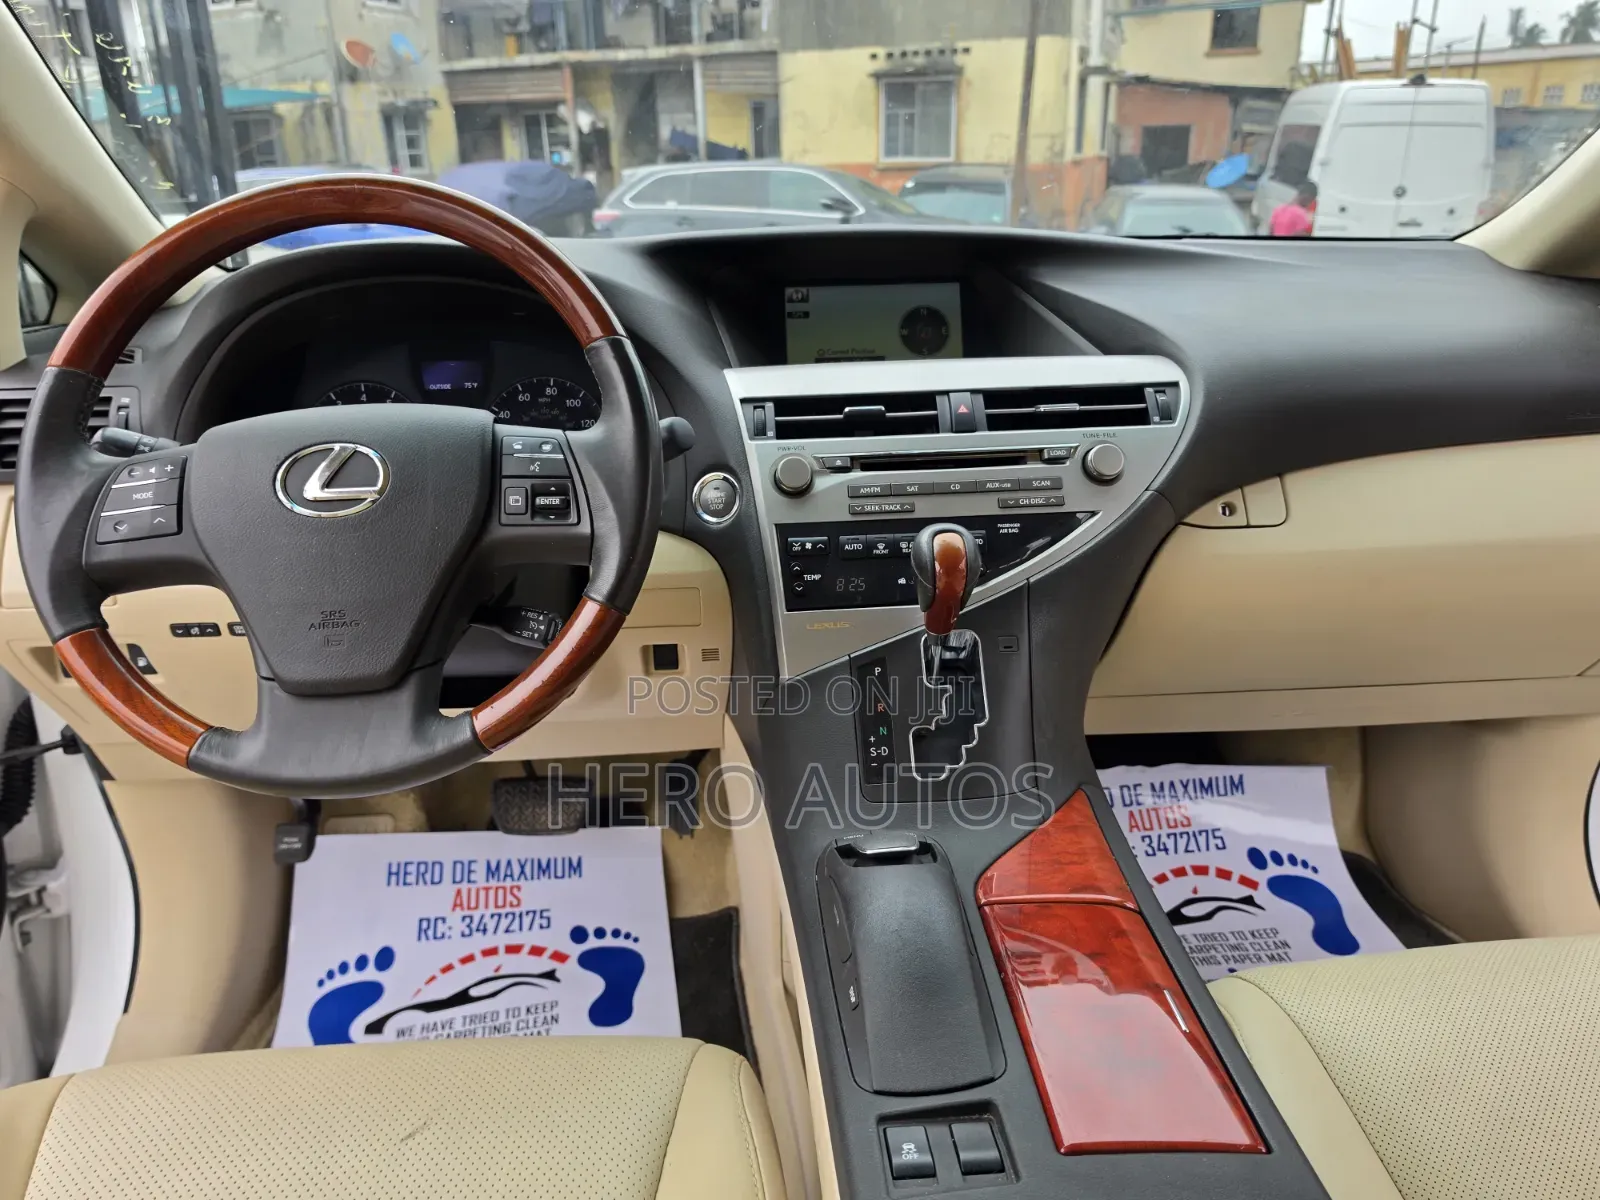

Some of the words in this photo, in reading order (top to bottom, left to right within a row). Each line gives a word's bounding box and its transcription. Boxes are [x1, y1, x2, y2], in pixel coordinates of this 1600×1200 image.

[545, 387, 558, 396] 80
[360, 393, 367, 402] 4
[518, 393, 530, 401] 60
[565, 399, 582, 407] 100
[498, 410, 510, 419] 40
[580, 419, 596, 428] 120
[132, 491, 154, 500] MODE
[844, 543, 863, 551] AUTO
[320, 609, 346, 619] SRS
[526, 611, 539, 619] RES
[308, 619, 361, 631] AIRBAG
[806, 621, 851, 630] LEXUS
[521, 630, 533, 638] SET
[874, 667, 882, 676] P
[877, 703, 886, 712] R
[879, 727, 888, 735] N
[1119, 783, 1144, 808] DE
[1149, 773, 1245, 805] MAXIMUM
[1128, 804, 1192, 833] AUTOS
[1140, 828, 1227, 858] 3472175
[452, 859, 478, 885] DE
[485, 856, 583, 884] MAXIMUM
[451, 884, 522, 912] AUTOS
[417, 916, 453, 942] RC:
[460, 908, 552, 939] 3472175
[1192, 931, 1230, 944] TRIED
[1229, 929, 1249, 941] TO
[1248, 927, 1280, 940] KEEP
[1186, 942, 1250, 956] ARPETING
[1249, 939, 1292, 953] CLEAN
[1190, 954, 1222, 967] THIS
[1221, 952, 1267, 966] PAPER
[1264, 951, 1293, 963] MAT
[396, 1024, 417, 1039] WE
[420, 1017, 457, 1034] HAVE
[461, 1010, 500, 1028] TRIED
[504, 1006, 522, 1020] TO
[525, 999, 559, 1016] KEEP
[515, 1013, 560, 1031] CLEAN
[902, 1152, 919, 1161] OFF
